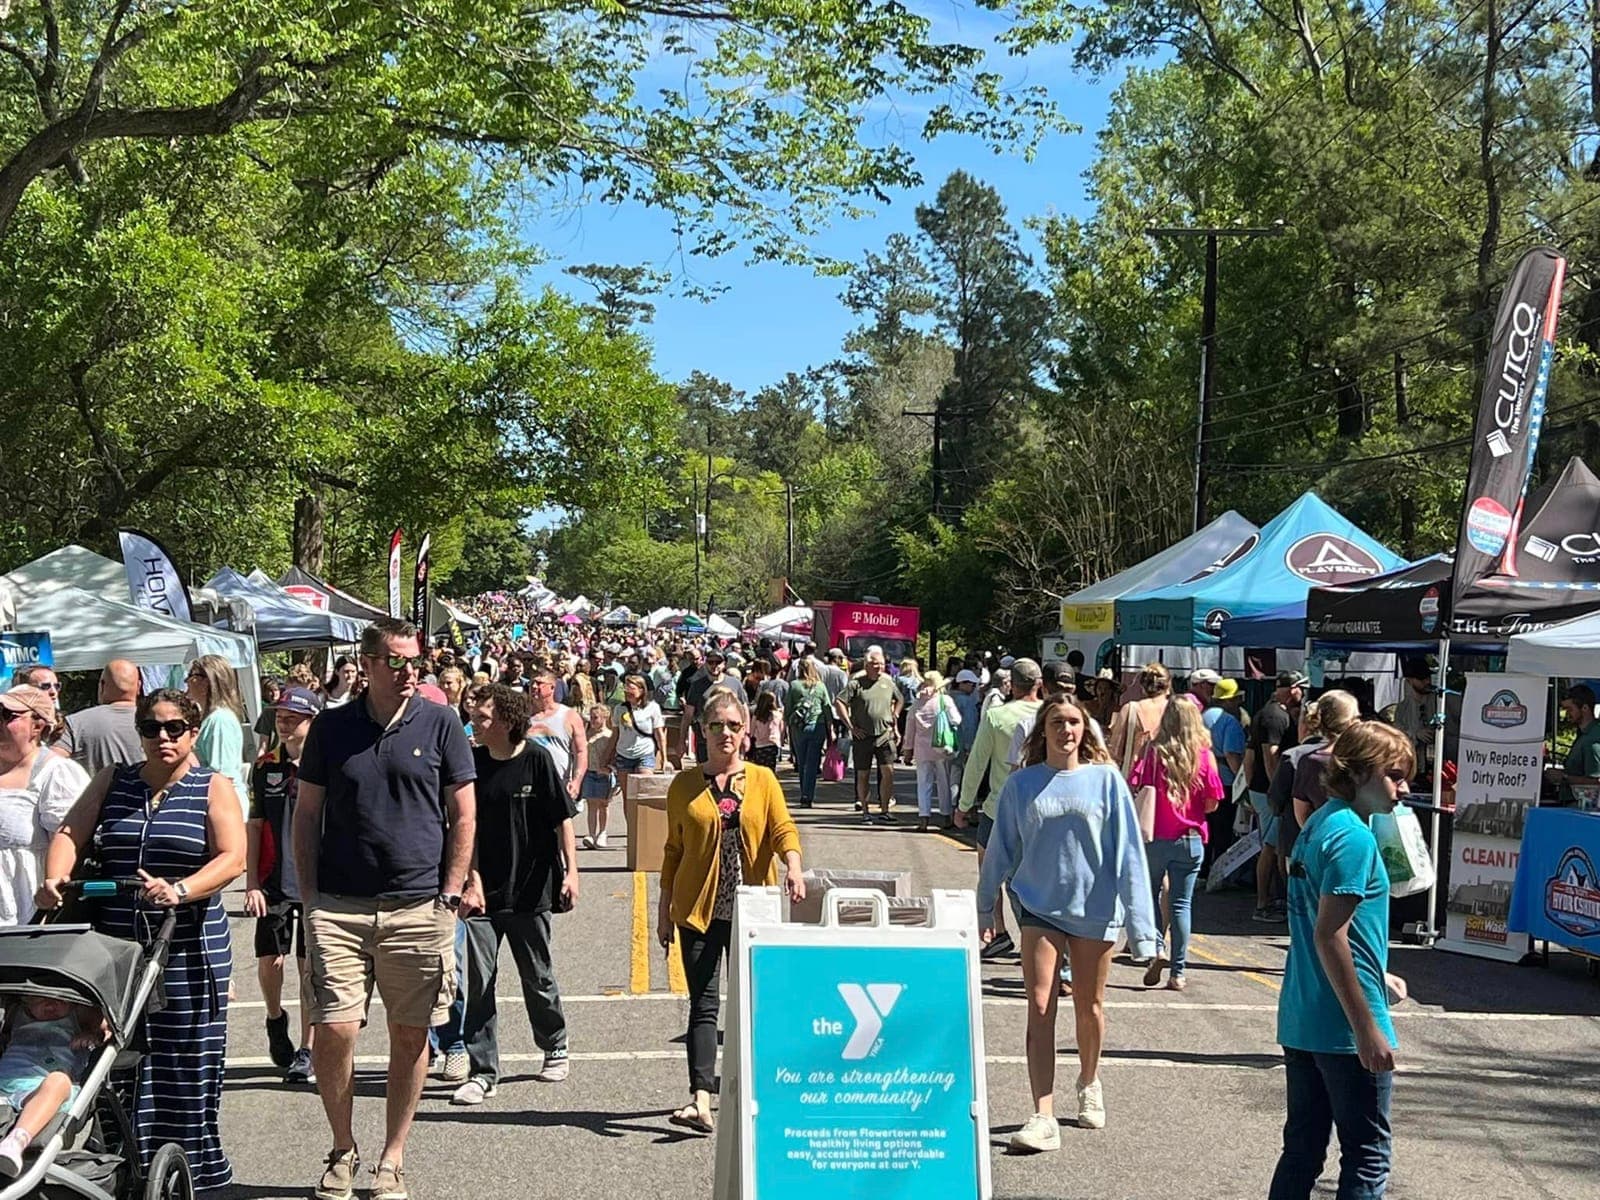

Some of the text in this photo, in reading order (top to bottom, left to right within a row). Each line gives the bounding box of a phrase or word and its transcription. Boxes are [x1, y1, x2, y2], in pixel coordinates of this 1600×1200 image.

[1494, 302, 1534, 428] CUTCO
[863, 612, 900, 626] Mobile
[1454, 619, 1488, 633] THE
[4, 646, 40, 663] MMC
[1466, 749, 1538, 767] Why Replace a
[1472, 770, 1527, 787] Dirty Roof?
[1462, 847, 1506, 867] CLEAN
[812, 1016, 842, 1035] the
[775, 1067, 955, 1091] You are strengthening
[800, 1089, 932, 1111] our community!
[784, 1127, 947, 1138] Proceeds from Flowertown make
[853, 1139, 881, 1149] living
[884, 1139, 922, 1149] options
[787, 1149, 945, 1160] easy, accessible and affordable
[812, 1160, 921, 1171] for everyone at our Y.
